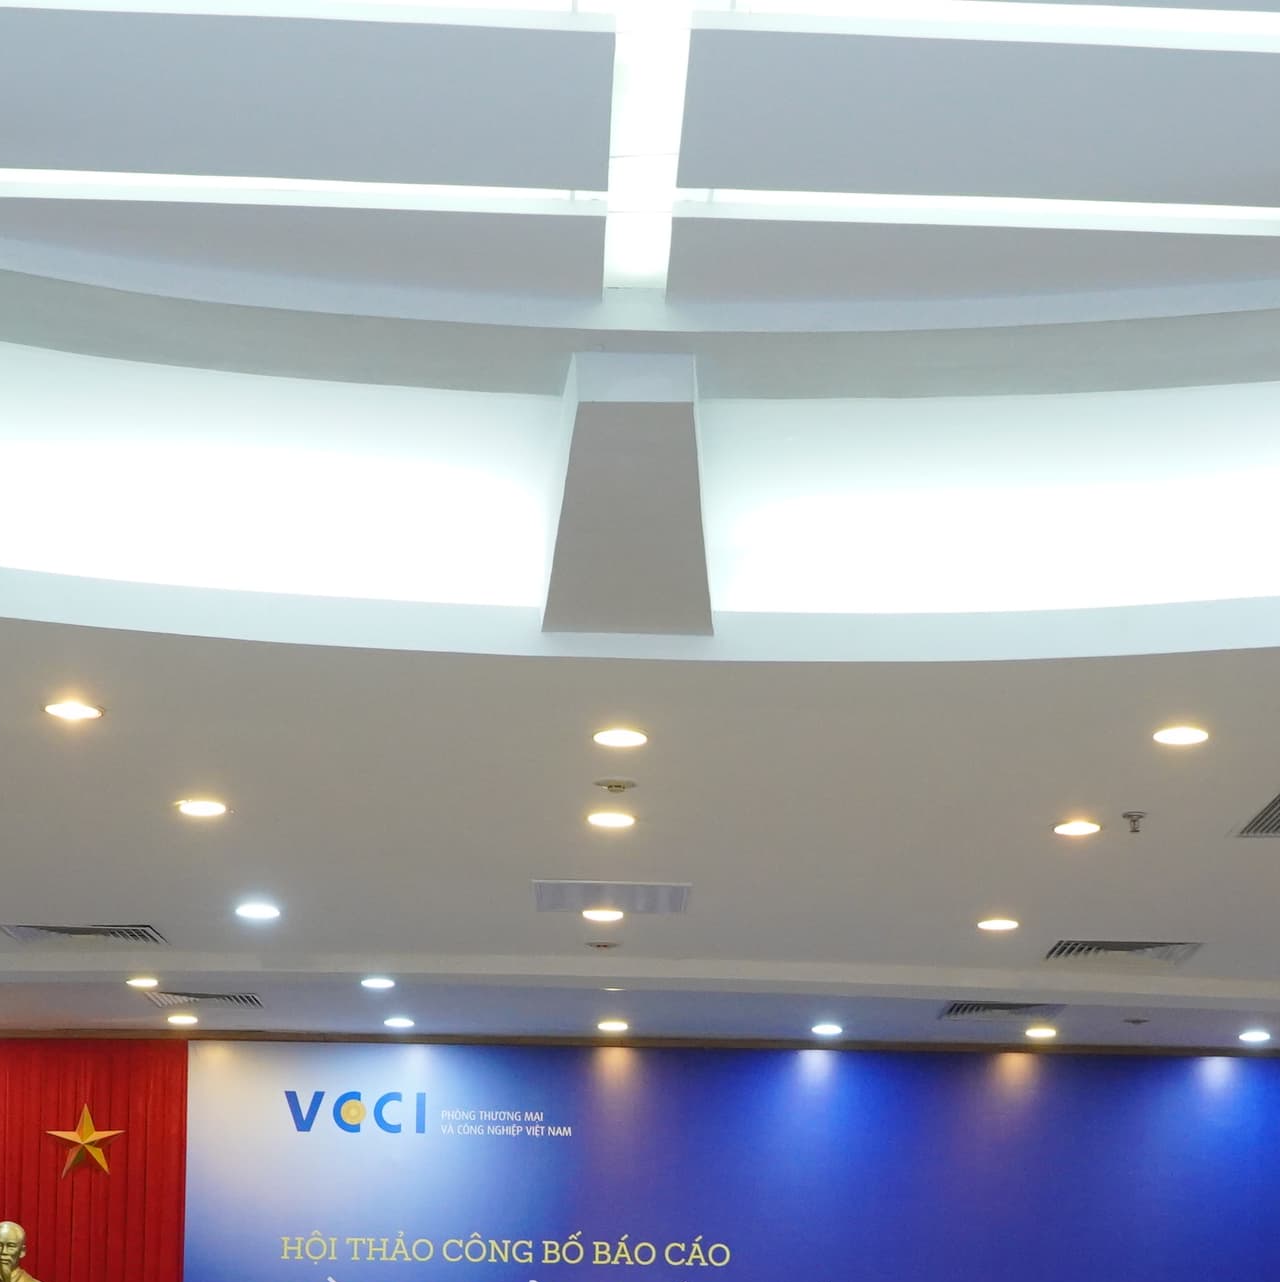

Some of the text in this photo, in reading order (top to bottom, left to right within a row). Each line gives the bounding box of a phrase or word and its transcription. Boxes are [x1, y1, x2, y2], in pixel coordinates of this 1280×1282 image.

[285, 1090, 426, 1134] VCCI
[548, 1125, 572, 1138] NAM
[281, 1229, 730, 1267] HỘI THẢO CÔNG BỐ BÁO CÁO
